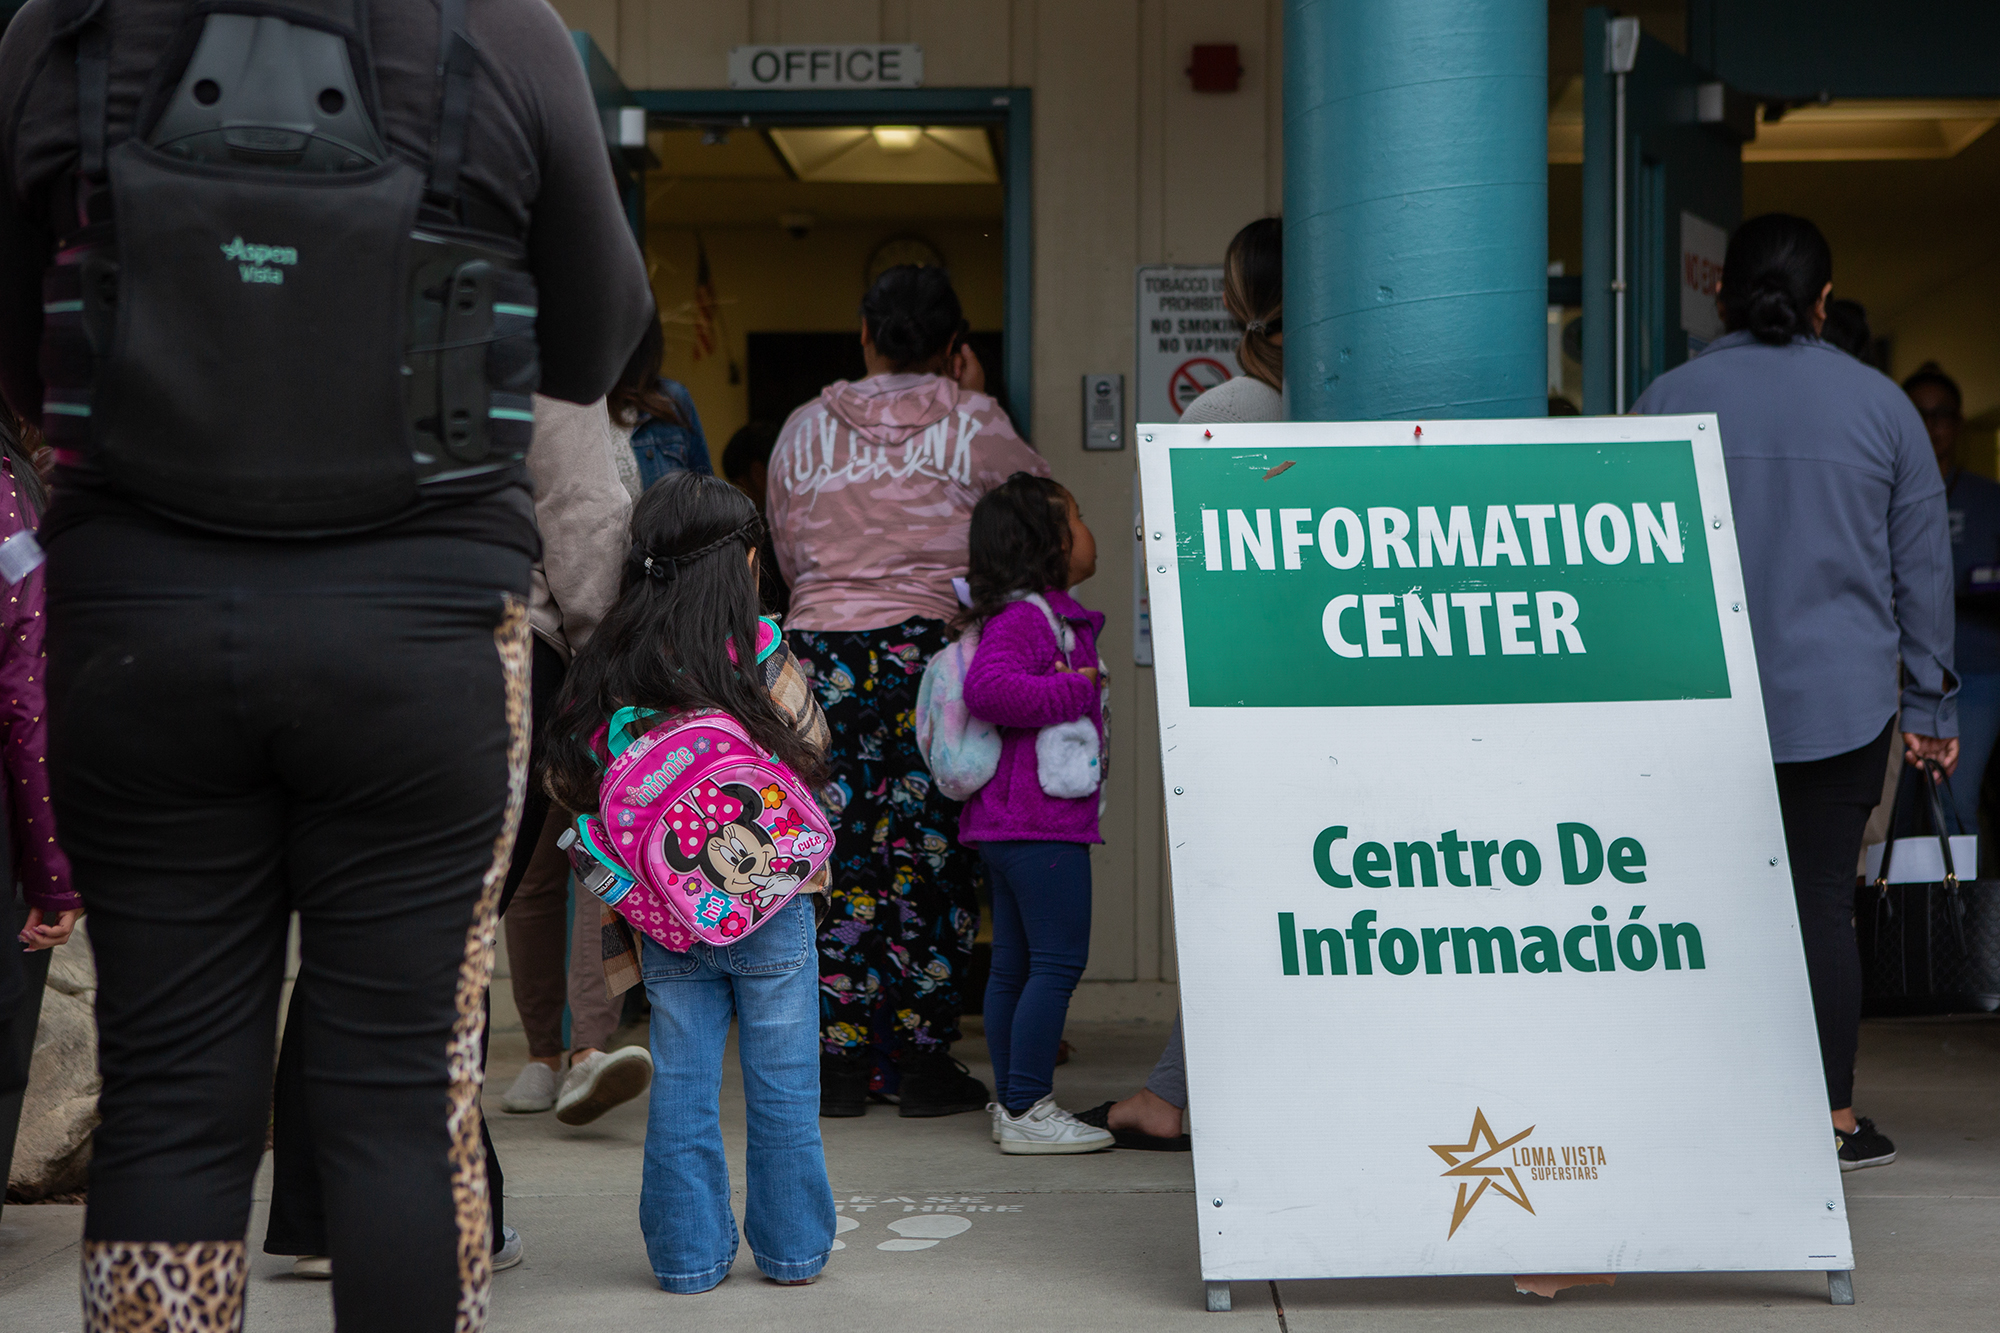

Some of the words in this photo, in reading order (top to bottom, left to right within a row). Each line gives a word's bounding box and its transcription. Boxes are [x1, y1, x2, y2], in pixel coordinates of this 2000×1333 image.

[752, 51, 900, 82] OFFICE
[1146, 277, 1209, 293] TOBACCO
[1160, 297, 1227, 312] PROHIBIT
[1151, 319, 1172, 334] NO
[1178, 319, 1239, 334] SMOKIN
[1159, 338, 1180, 352] NO
[798, 445, 949, 512] pink
[1201, 501, 1685, 571] INFORMATION
[1321, 591, 1587, 659] CENTER
[636, 747, 695, 807] minnie
[797, 834, 822, 852] cute
[1312, 825, 1542, 889] Centro
[1556, 822, 1647, 885] De
[701, 896, 725, 921] hi!
[1277, 905, 1706, 976] Información
[1512, 1147, 1556, 1166] LOMA
[1561, 1146, 1606, 1166] VISTA
[1531, 1166, 1598, 1181] SUPERSTARS
